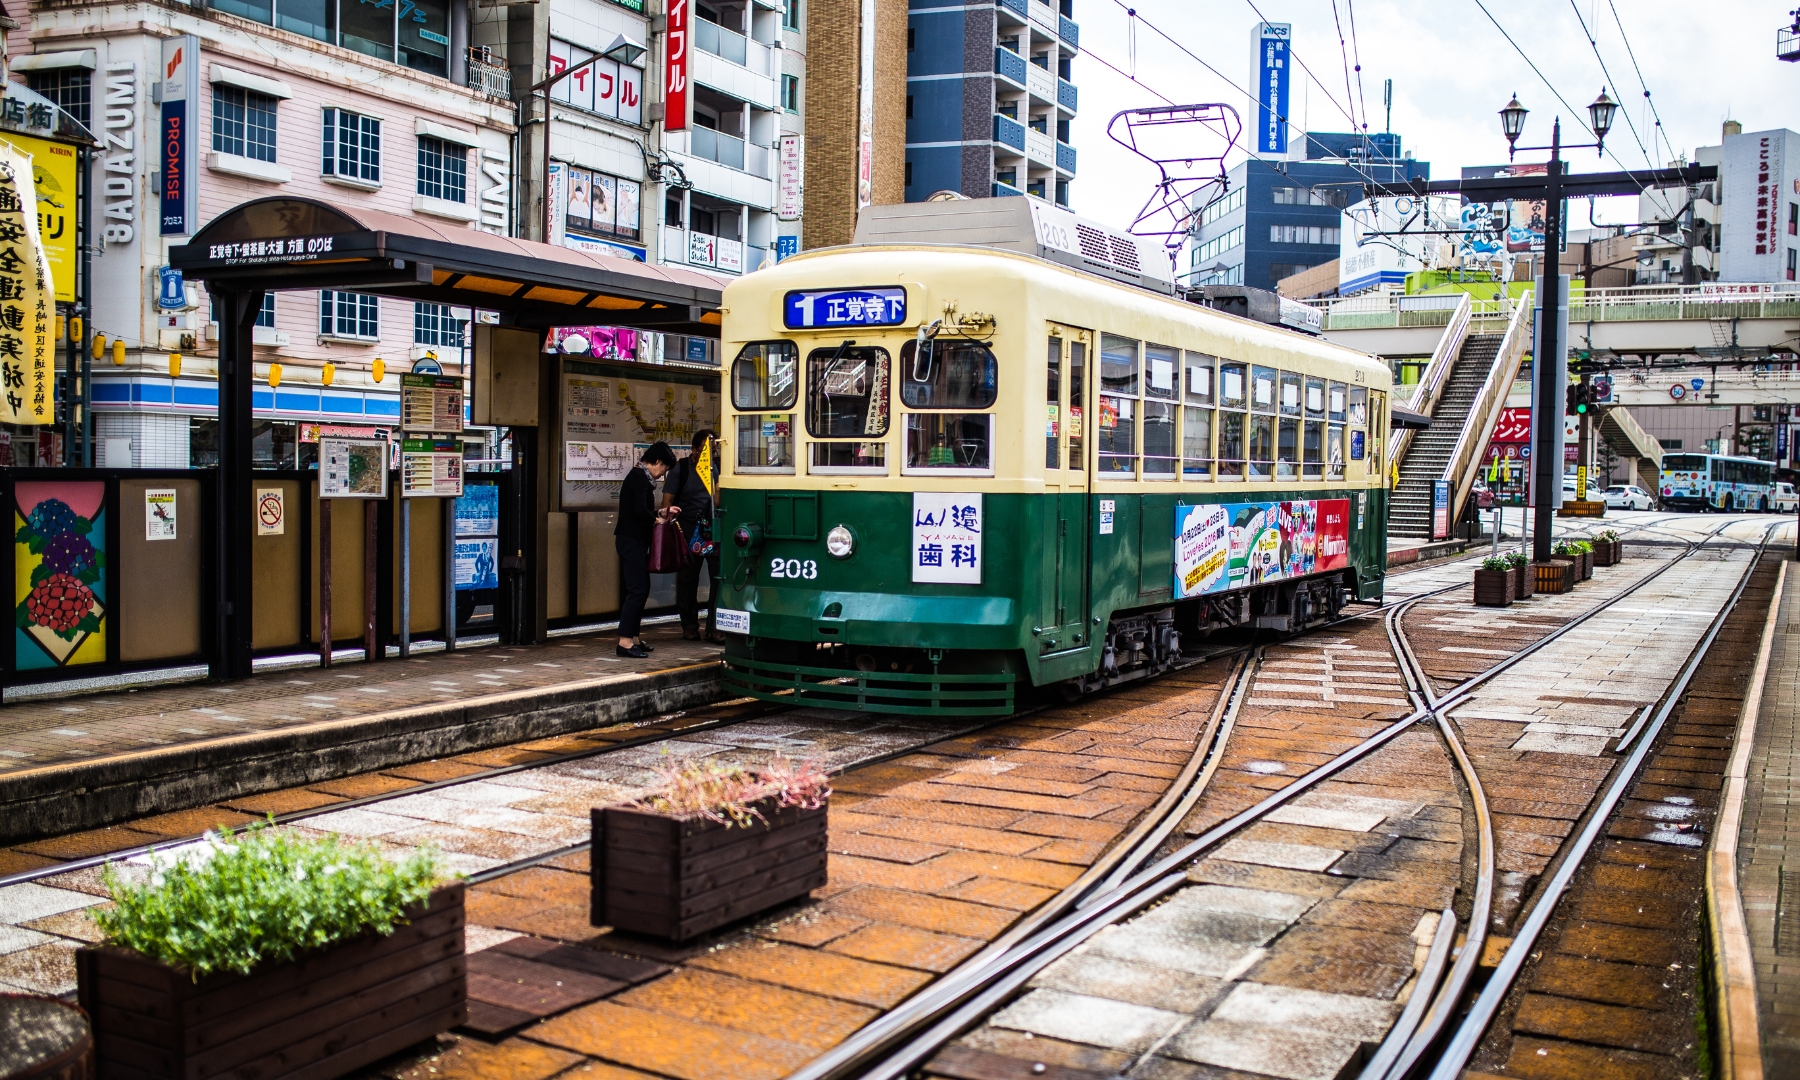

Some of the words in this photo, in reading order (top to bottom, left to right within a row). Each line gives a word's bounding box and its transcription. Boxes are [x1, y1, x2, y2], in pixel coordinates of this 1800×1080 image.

[50, 146, 73, 158] KIRIN
[167, 117, 180, 200] PROMISE
[163, 216, 183, 226] プロミス
[287, 238, 304, 253] 方面
[307, 237, 333, 252] のりば
[1043, 222, 1070, 250] 203
[691, 253, 708, 263] Studio
[794, 296, 815, 326] 1
[826, 295, 904, 323] 正覚寺下
[1491, 447, 1499, 456] A
[1507, 447, 1516, 457] B
[1279, 506, 1293, 533] LIVE
[918, 543, 977, 568] 歯科
[770, 557, 818, 580] 203
